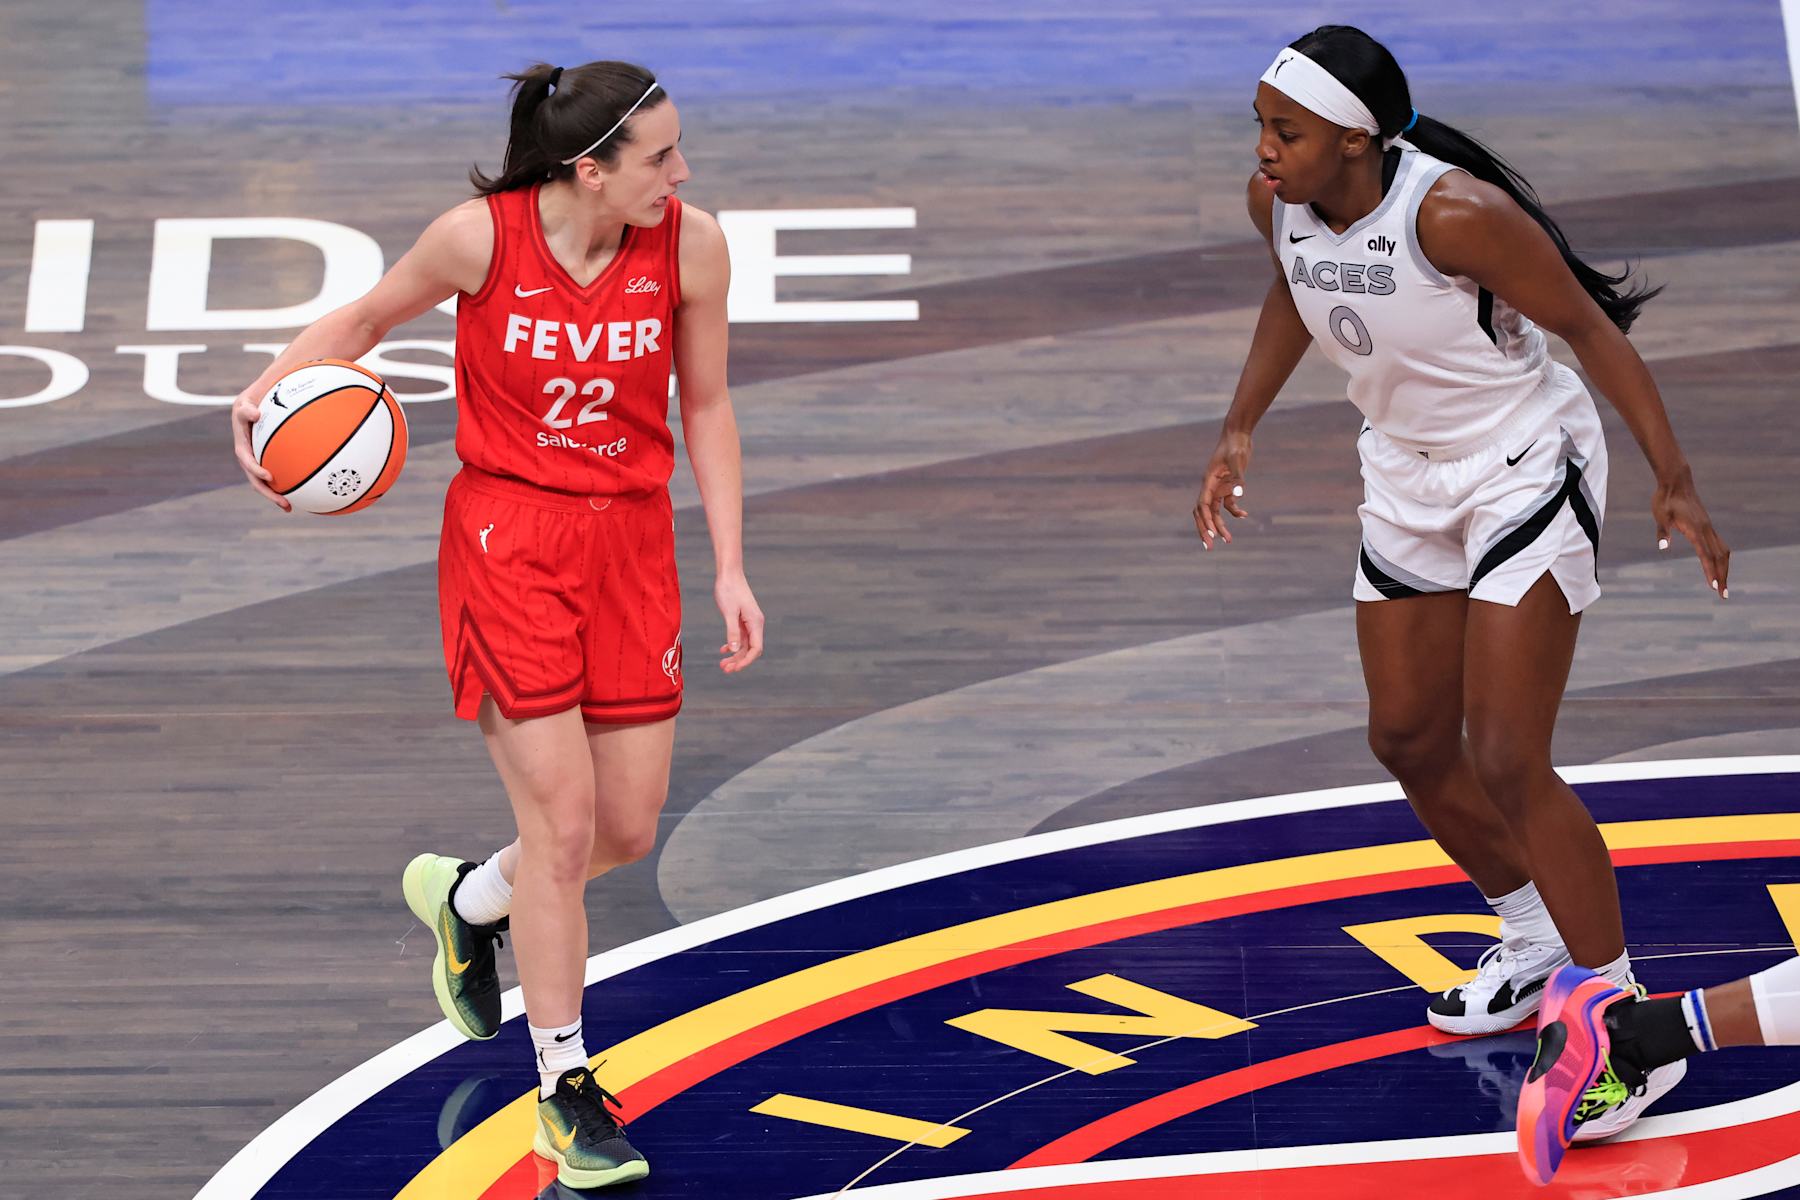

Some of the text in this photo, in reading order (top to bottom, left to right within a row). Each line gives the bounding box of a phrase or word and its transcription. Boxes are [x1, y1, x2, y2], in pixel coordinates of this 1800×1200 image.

[25, 207, 919, 332] IDE
[1367, 235, 1396, 256] ally
[624, 276, 661, 297] Lilly
[1291, 256, 1396, 295] ACES
[503, 313, 662, 362] FEVER
[1329, 305, 1373, 356] 0
[0, 339, 675, 408] OUS
[541, 377, 615, 429] 22
[536, 431, 627, 457] salrce
